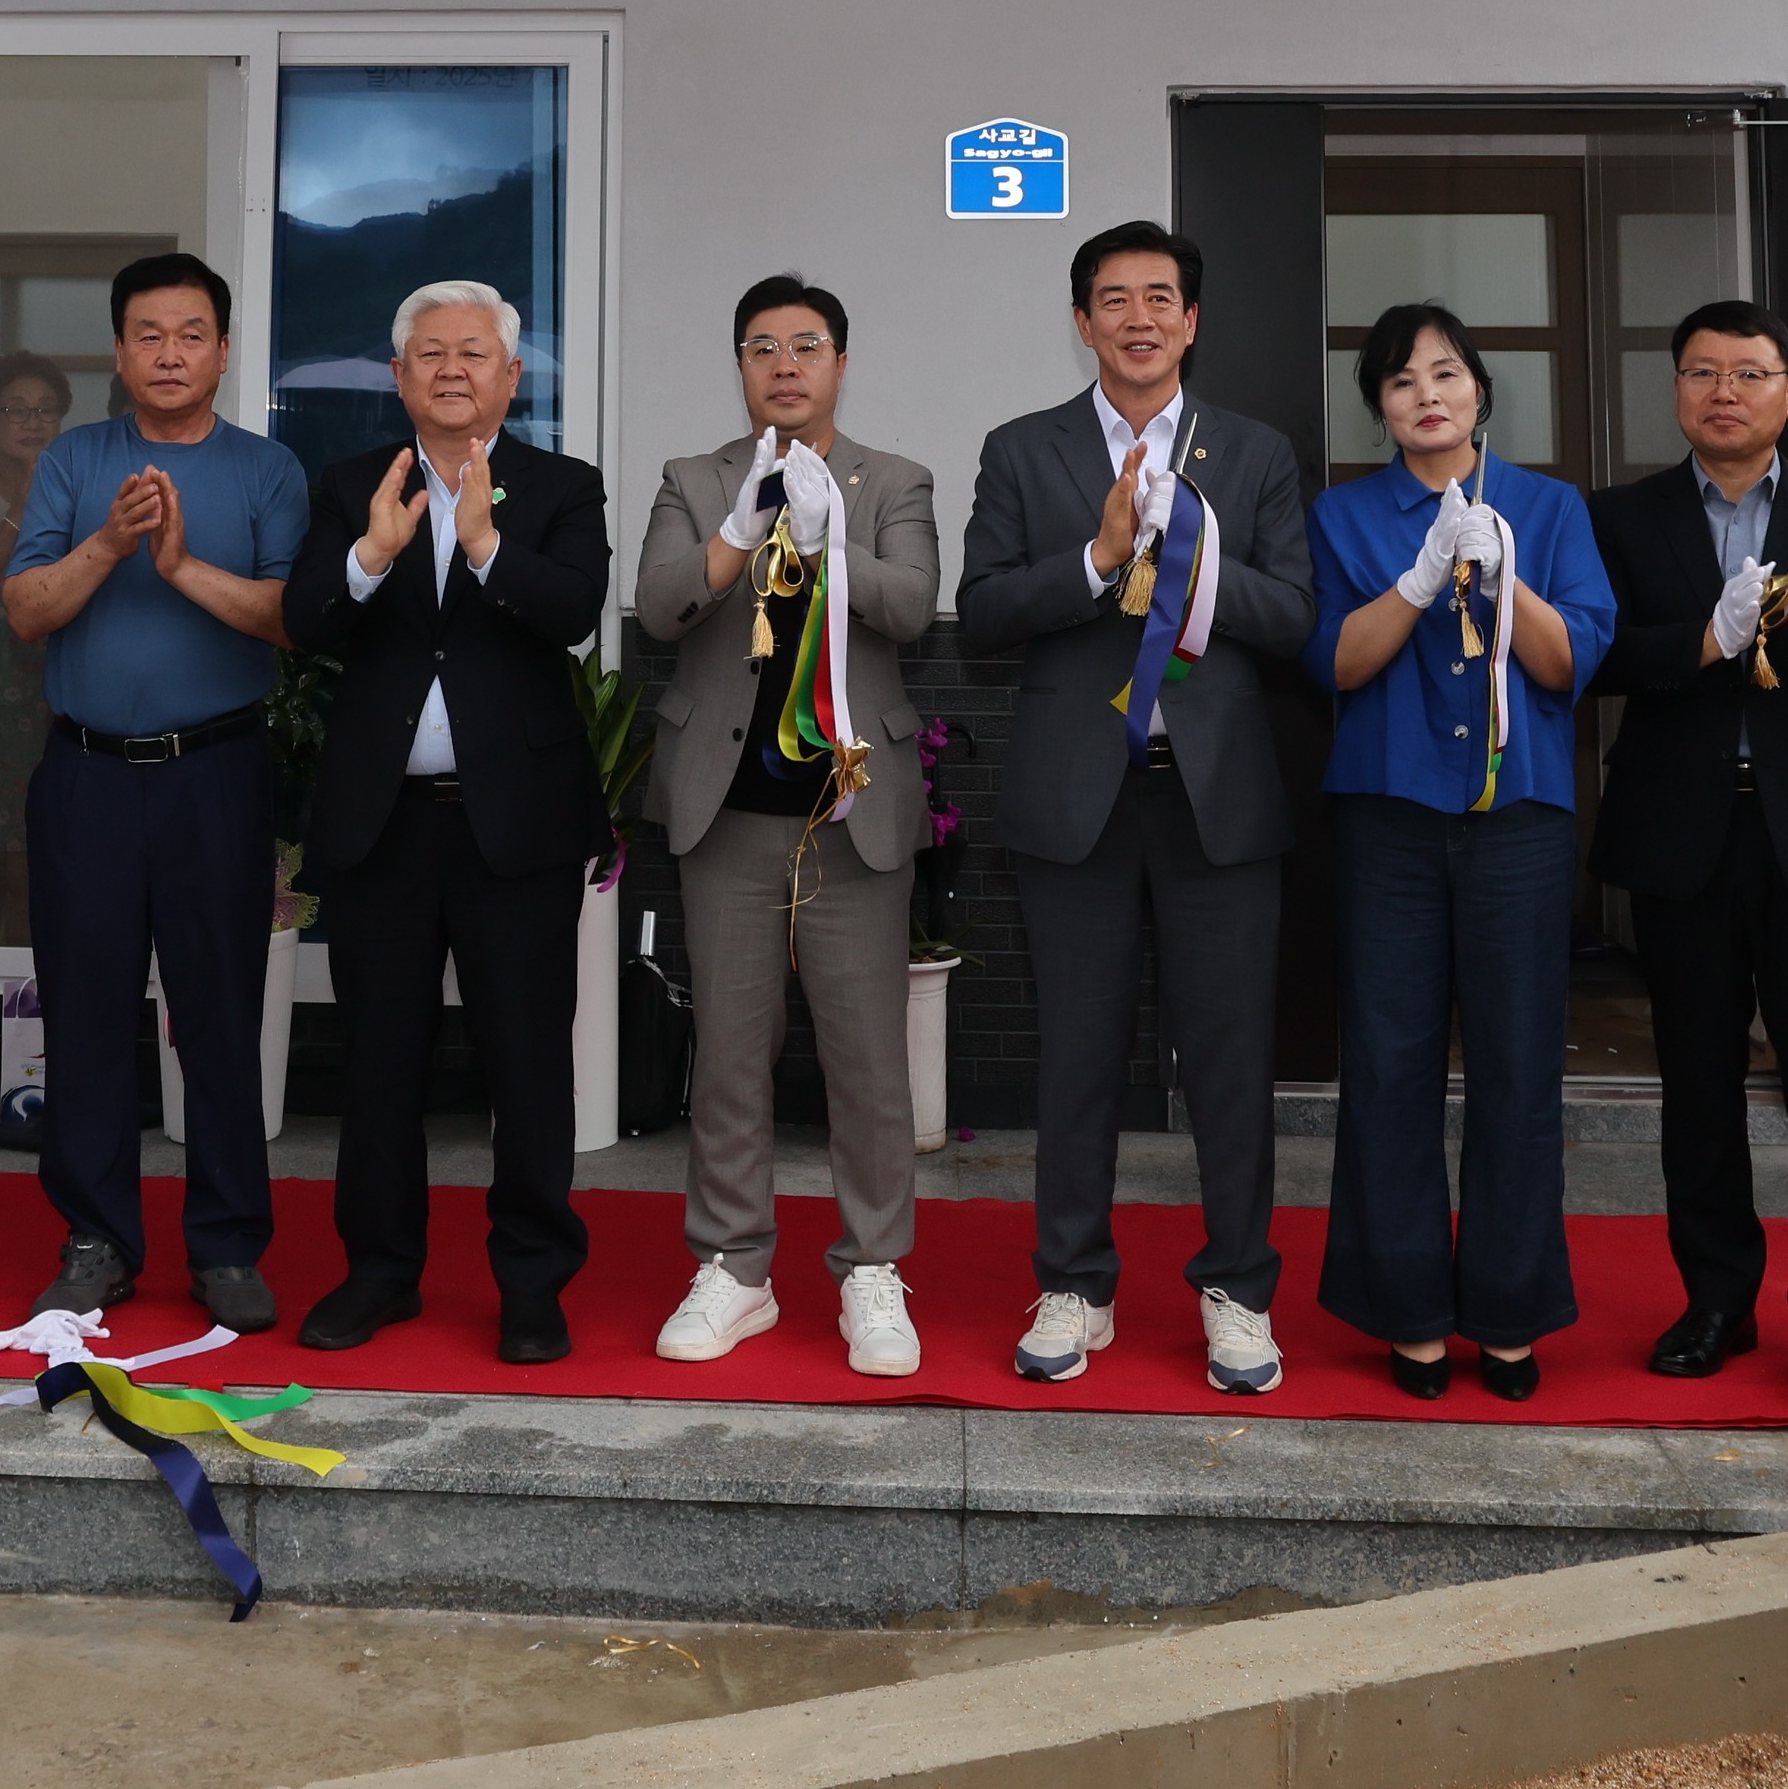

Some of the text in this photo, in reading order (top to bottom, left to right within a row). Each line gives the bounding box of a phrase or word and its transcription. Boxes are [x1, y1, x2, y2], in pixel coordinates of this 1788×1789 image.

[978, 128, 1038, 146] 사교길
[963, 148, 1054, 160] Sagyo-gil
[991, 165, 1024, 209] 3
